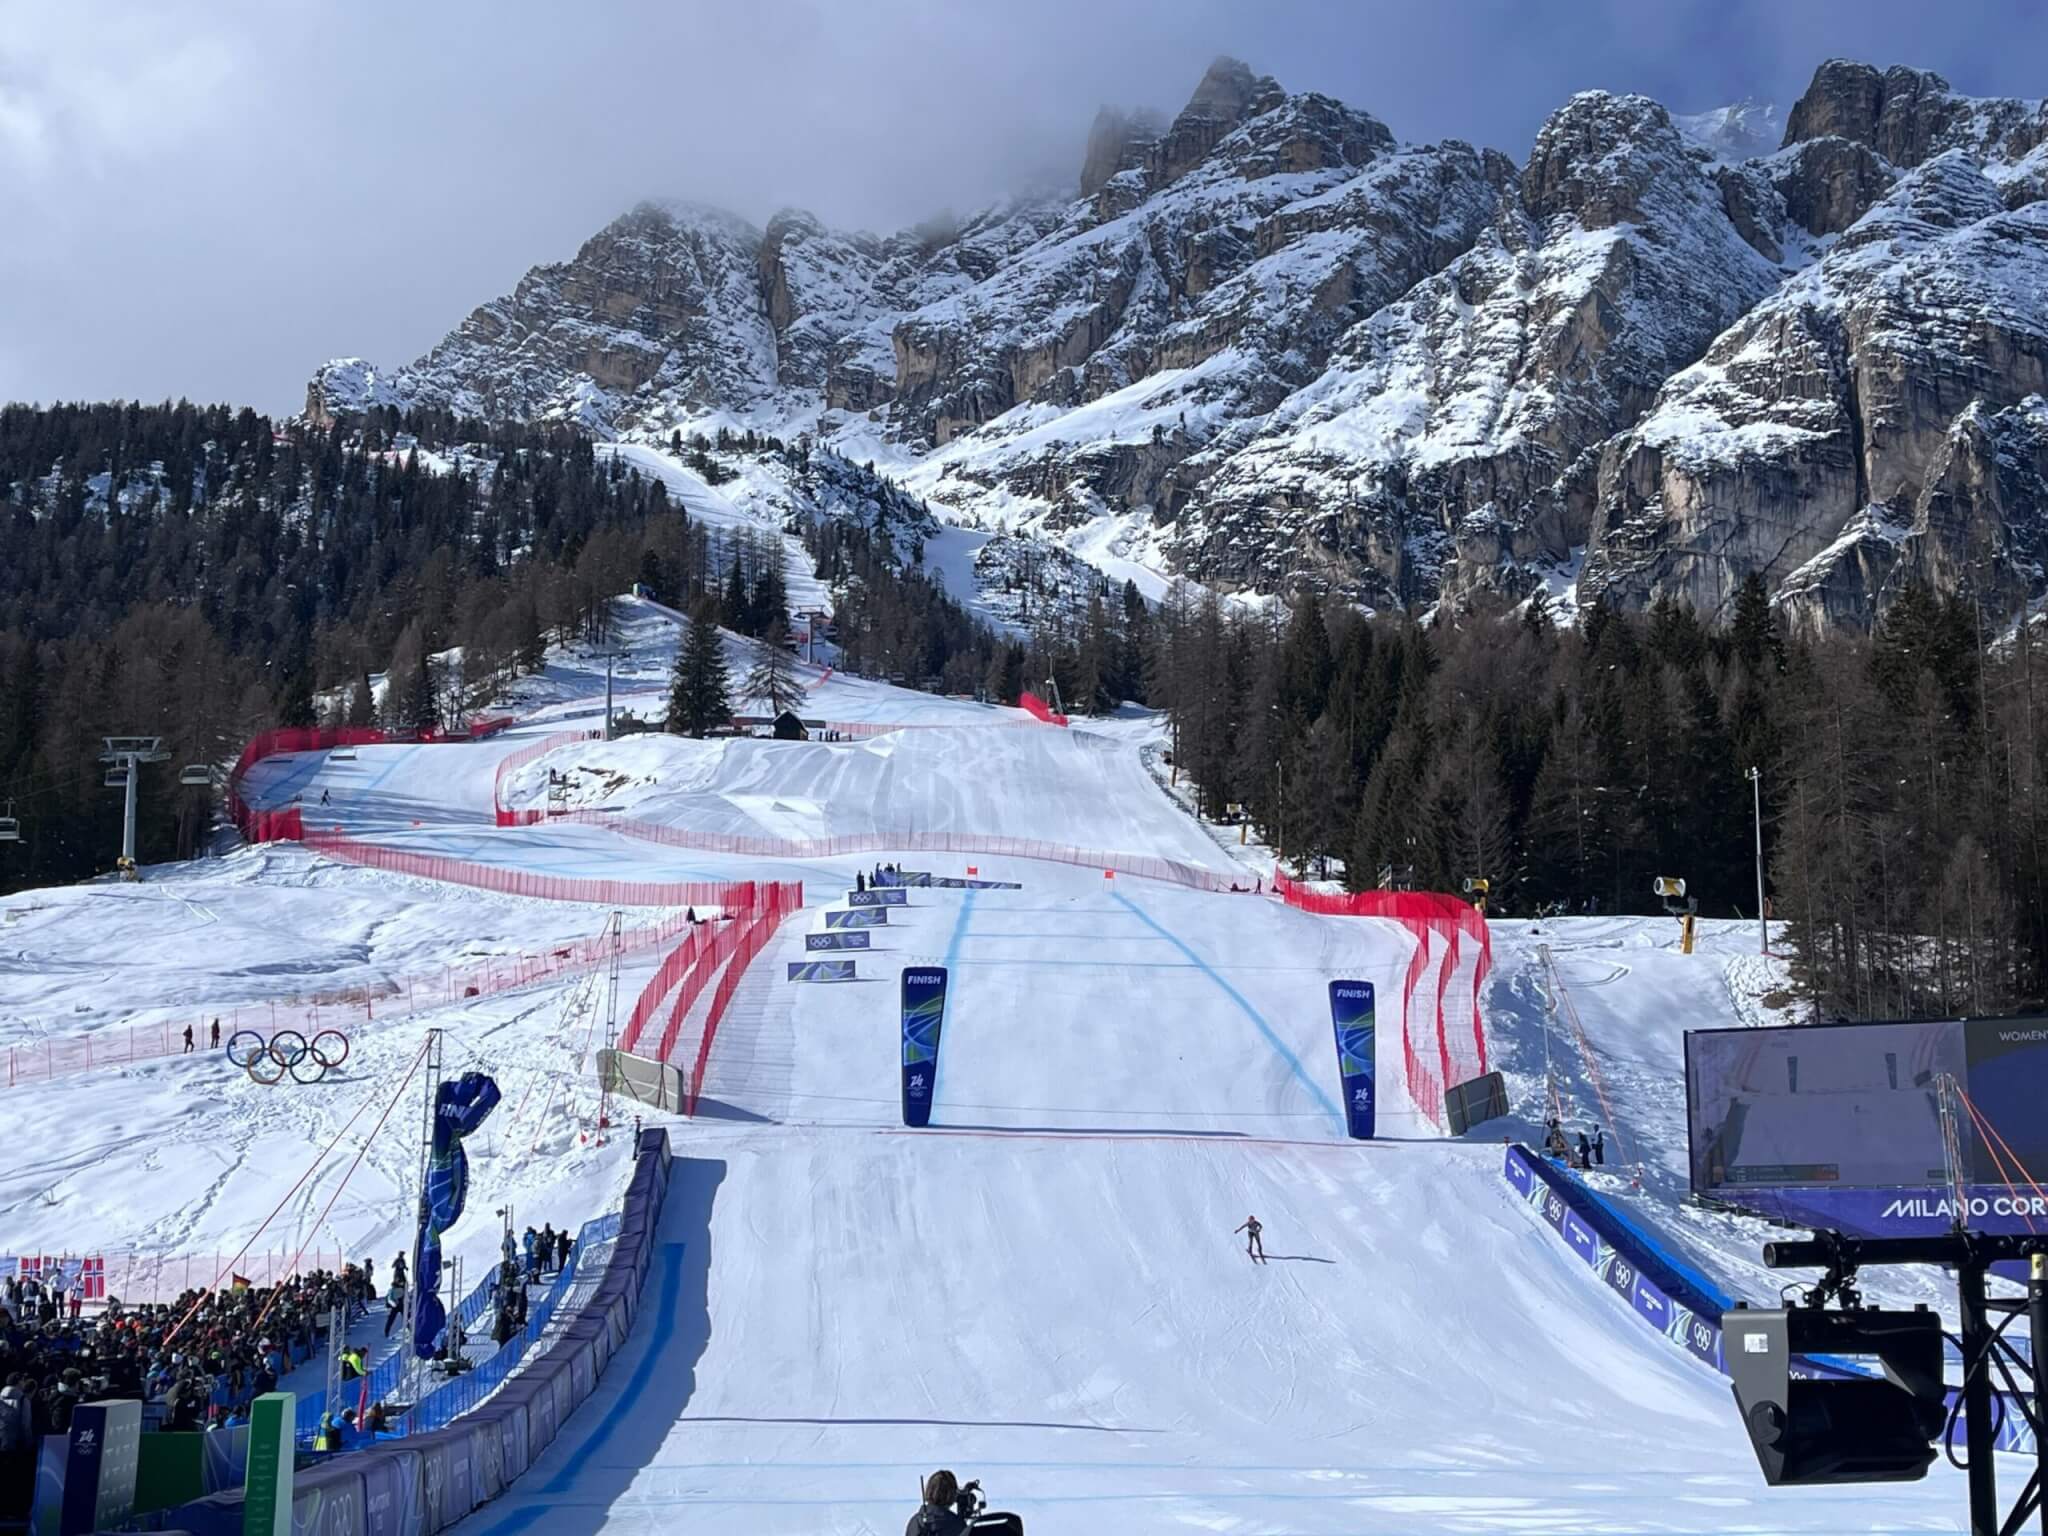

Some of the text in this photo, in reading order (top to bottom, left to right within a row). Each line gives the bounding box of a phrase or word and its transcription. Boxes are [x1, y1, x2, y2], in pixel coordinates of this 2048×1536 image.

[907, 975, 941, 985] FINISH
[1336, 989, 1370, 999] FINISH
[1881, 1197, 2047, 1218] MILANO COR
